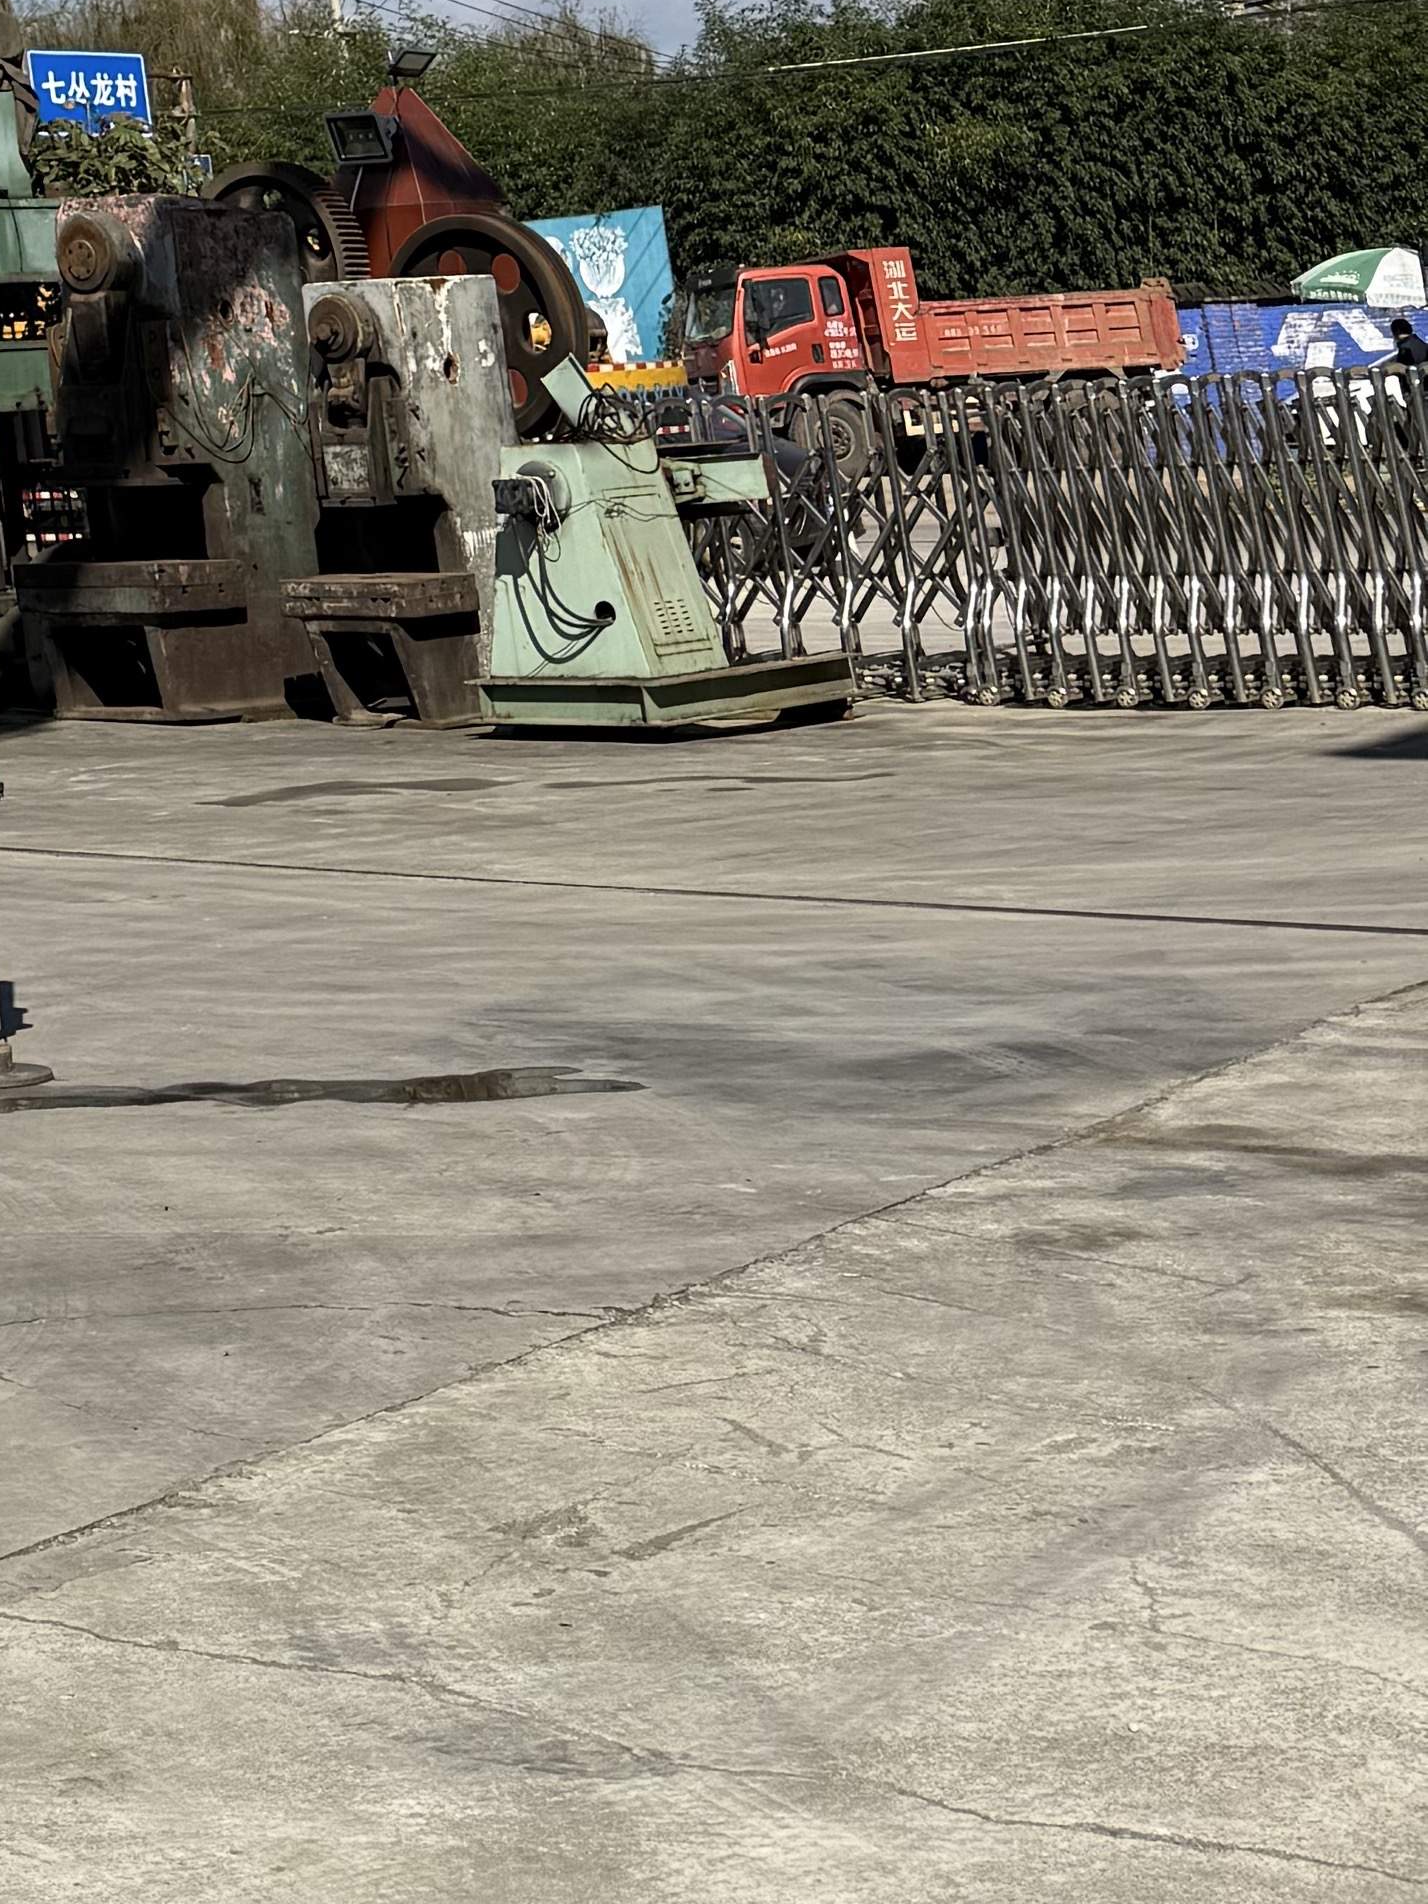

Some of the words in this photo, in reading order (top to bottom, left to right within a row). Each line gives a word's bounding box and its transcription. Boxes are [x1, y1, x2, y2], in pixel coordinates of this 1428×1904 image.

[41, 70, 137, 108] 七丛龙村
[882, 260, 918, 341] 湖北大运
